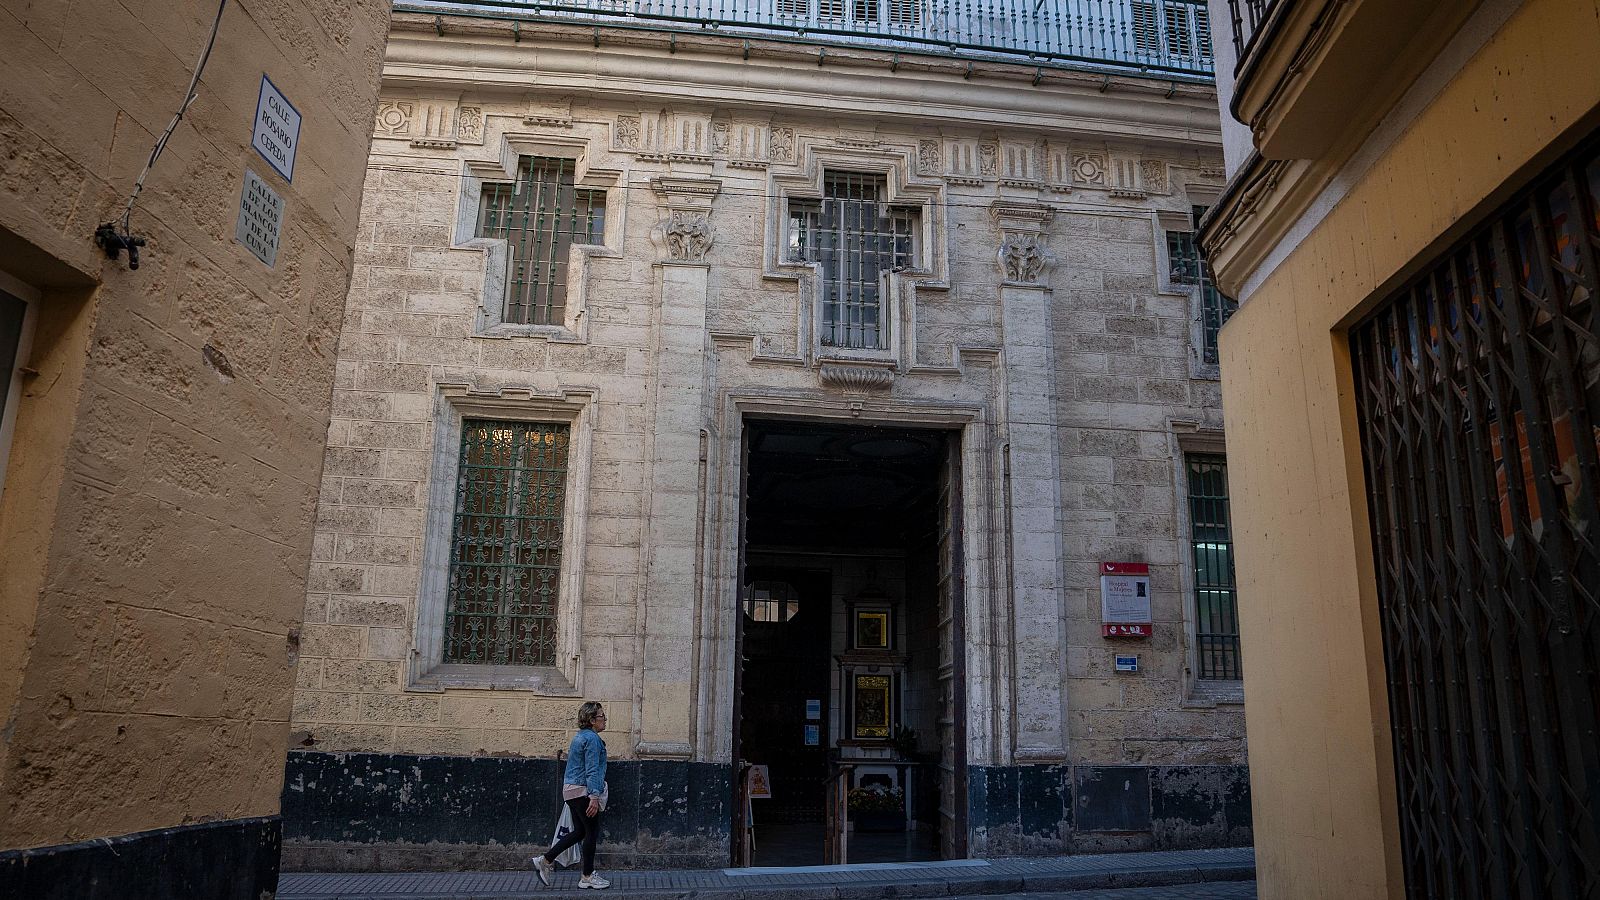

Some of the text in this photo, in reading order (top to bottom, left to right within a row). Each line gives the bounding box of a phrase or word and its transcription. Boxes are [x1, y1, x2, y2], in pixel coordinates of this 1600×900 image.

[268, 96, 291, 126] CALLE
[261, 110, 292, 149] ROSARIO
[260, 133, 286, 167] CEPEDA
[248, 190, 278, 223] DE LOS
[251, 179, 278, 209] CALLE
[242, 199, 278, 237] BLANCOS
[243, 214, 274, 249] Y DE LA
[246, 233, 267, 257] CUNA
